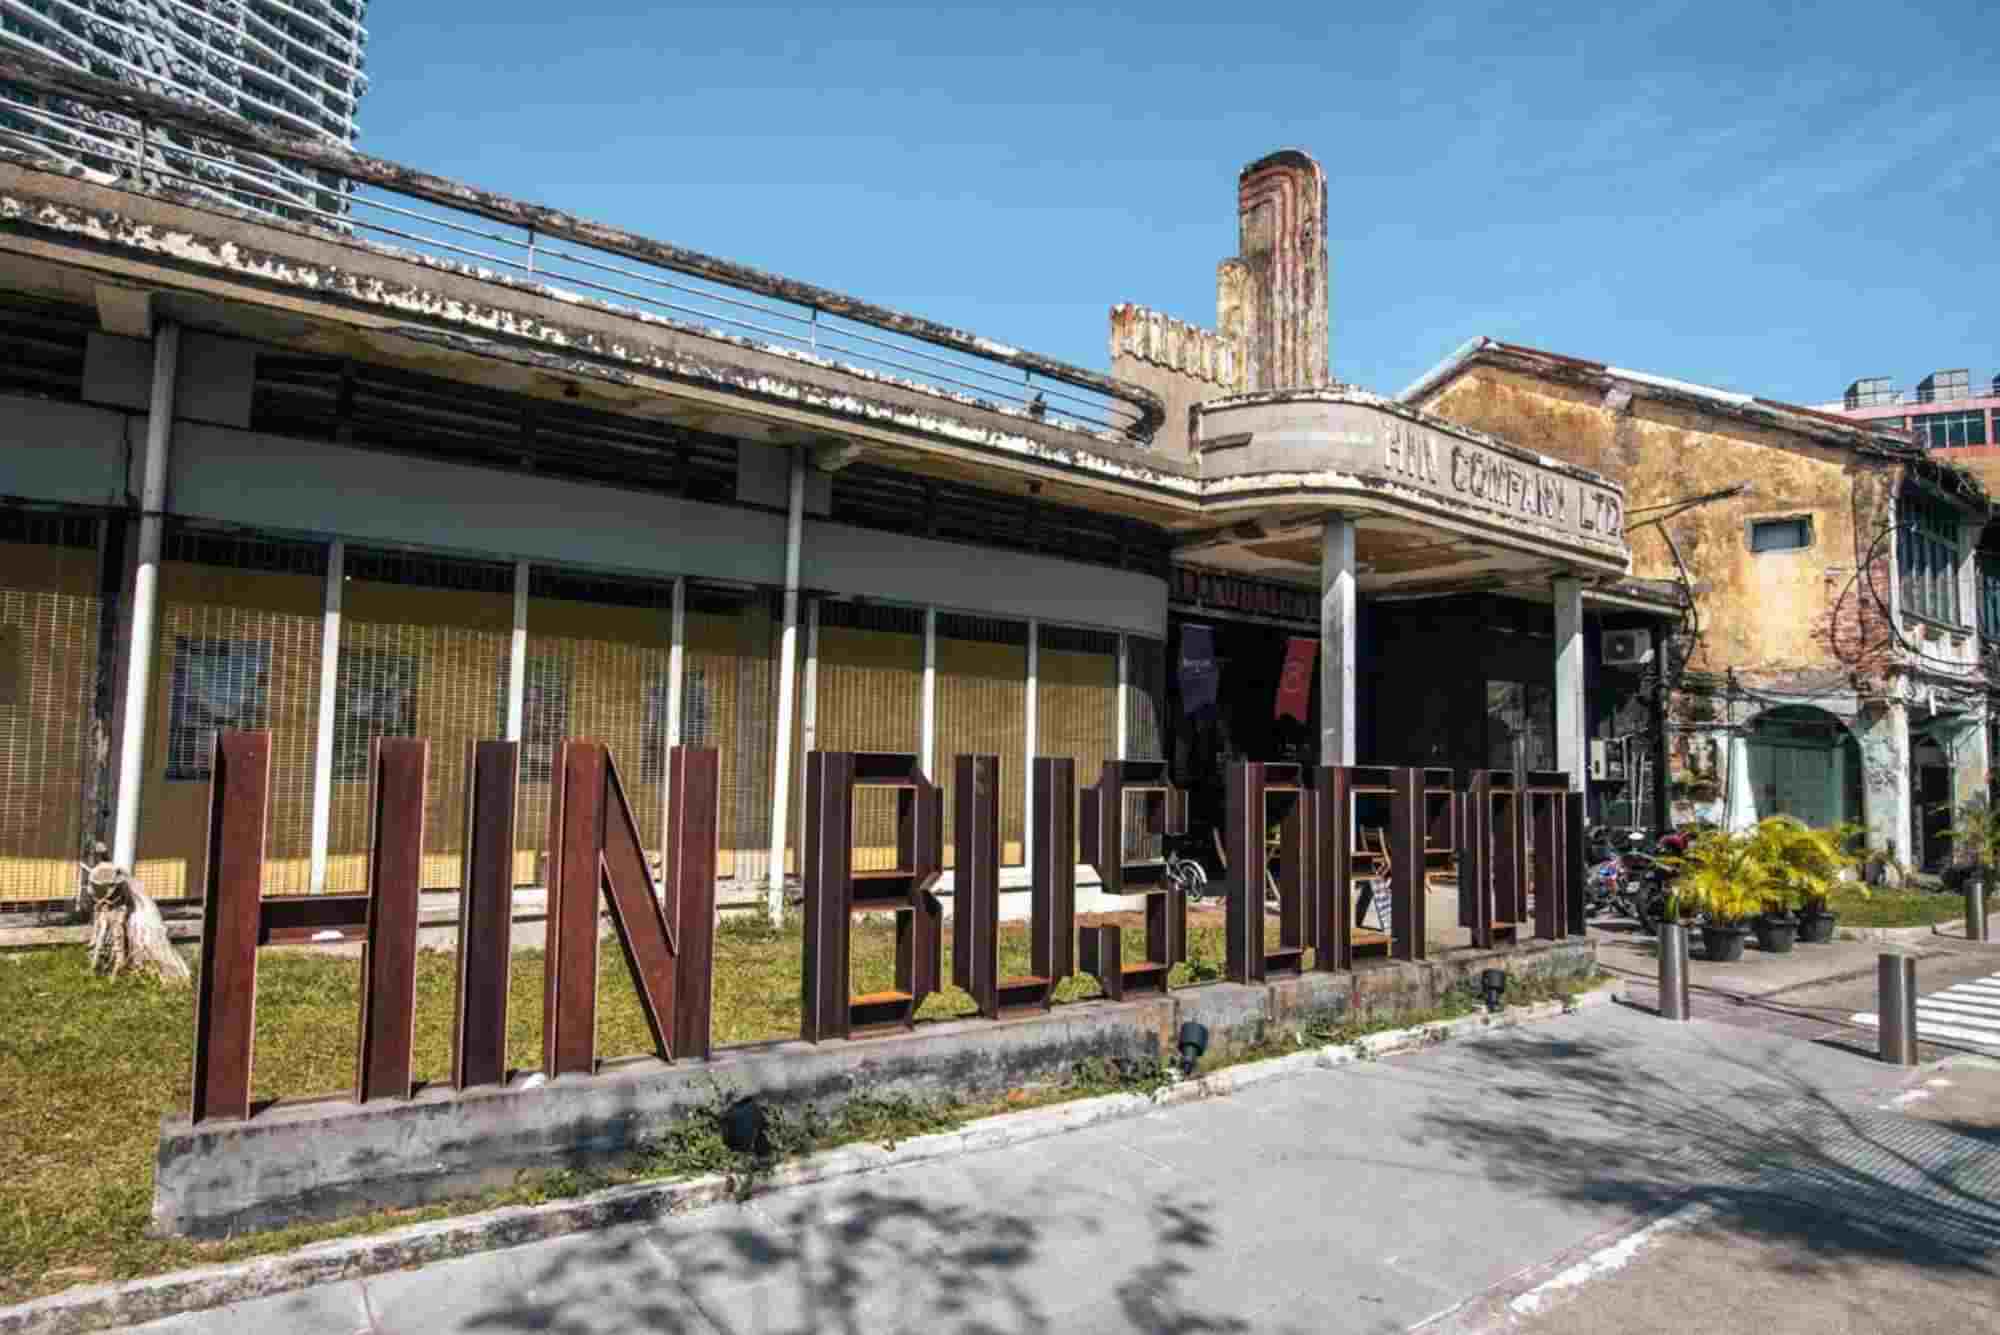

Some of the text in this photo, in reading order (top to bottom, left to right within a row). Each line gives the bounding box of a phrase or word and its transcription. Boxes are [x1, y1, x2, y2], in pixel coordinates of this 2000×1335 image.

[1383, 423, 1438, 485] HIN
[1451, 446, 1567, 522] COMPANY
[192, 728, 1584, 1125] HIN BUS DEPOT
